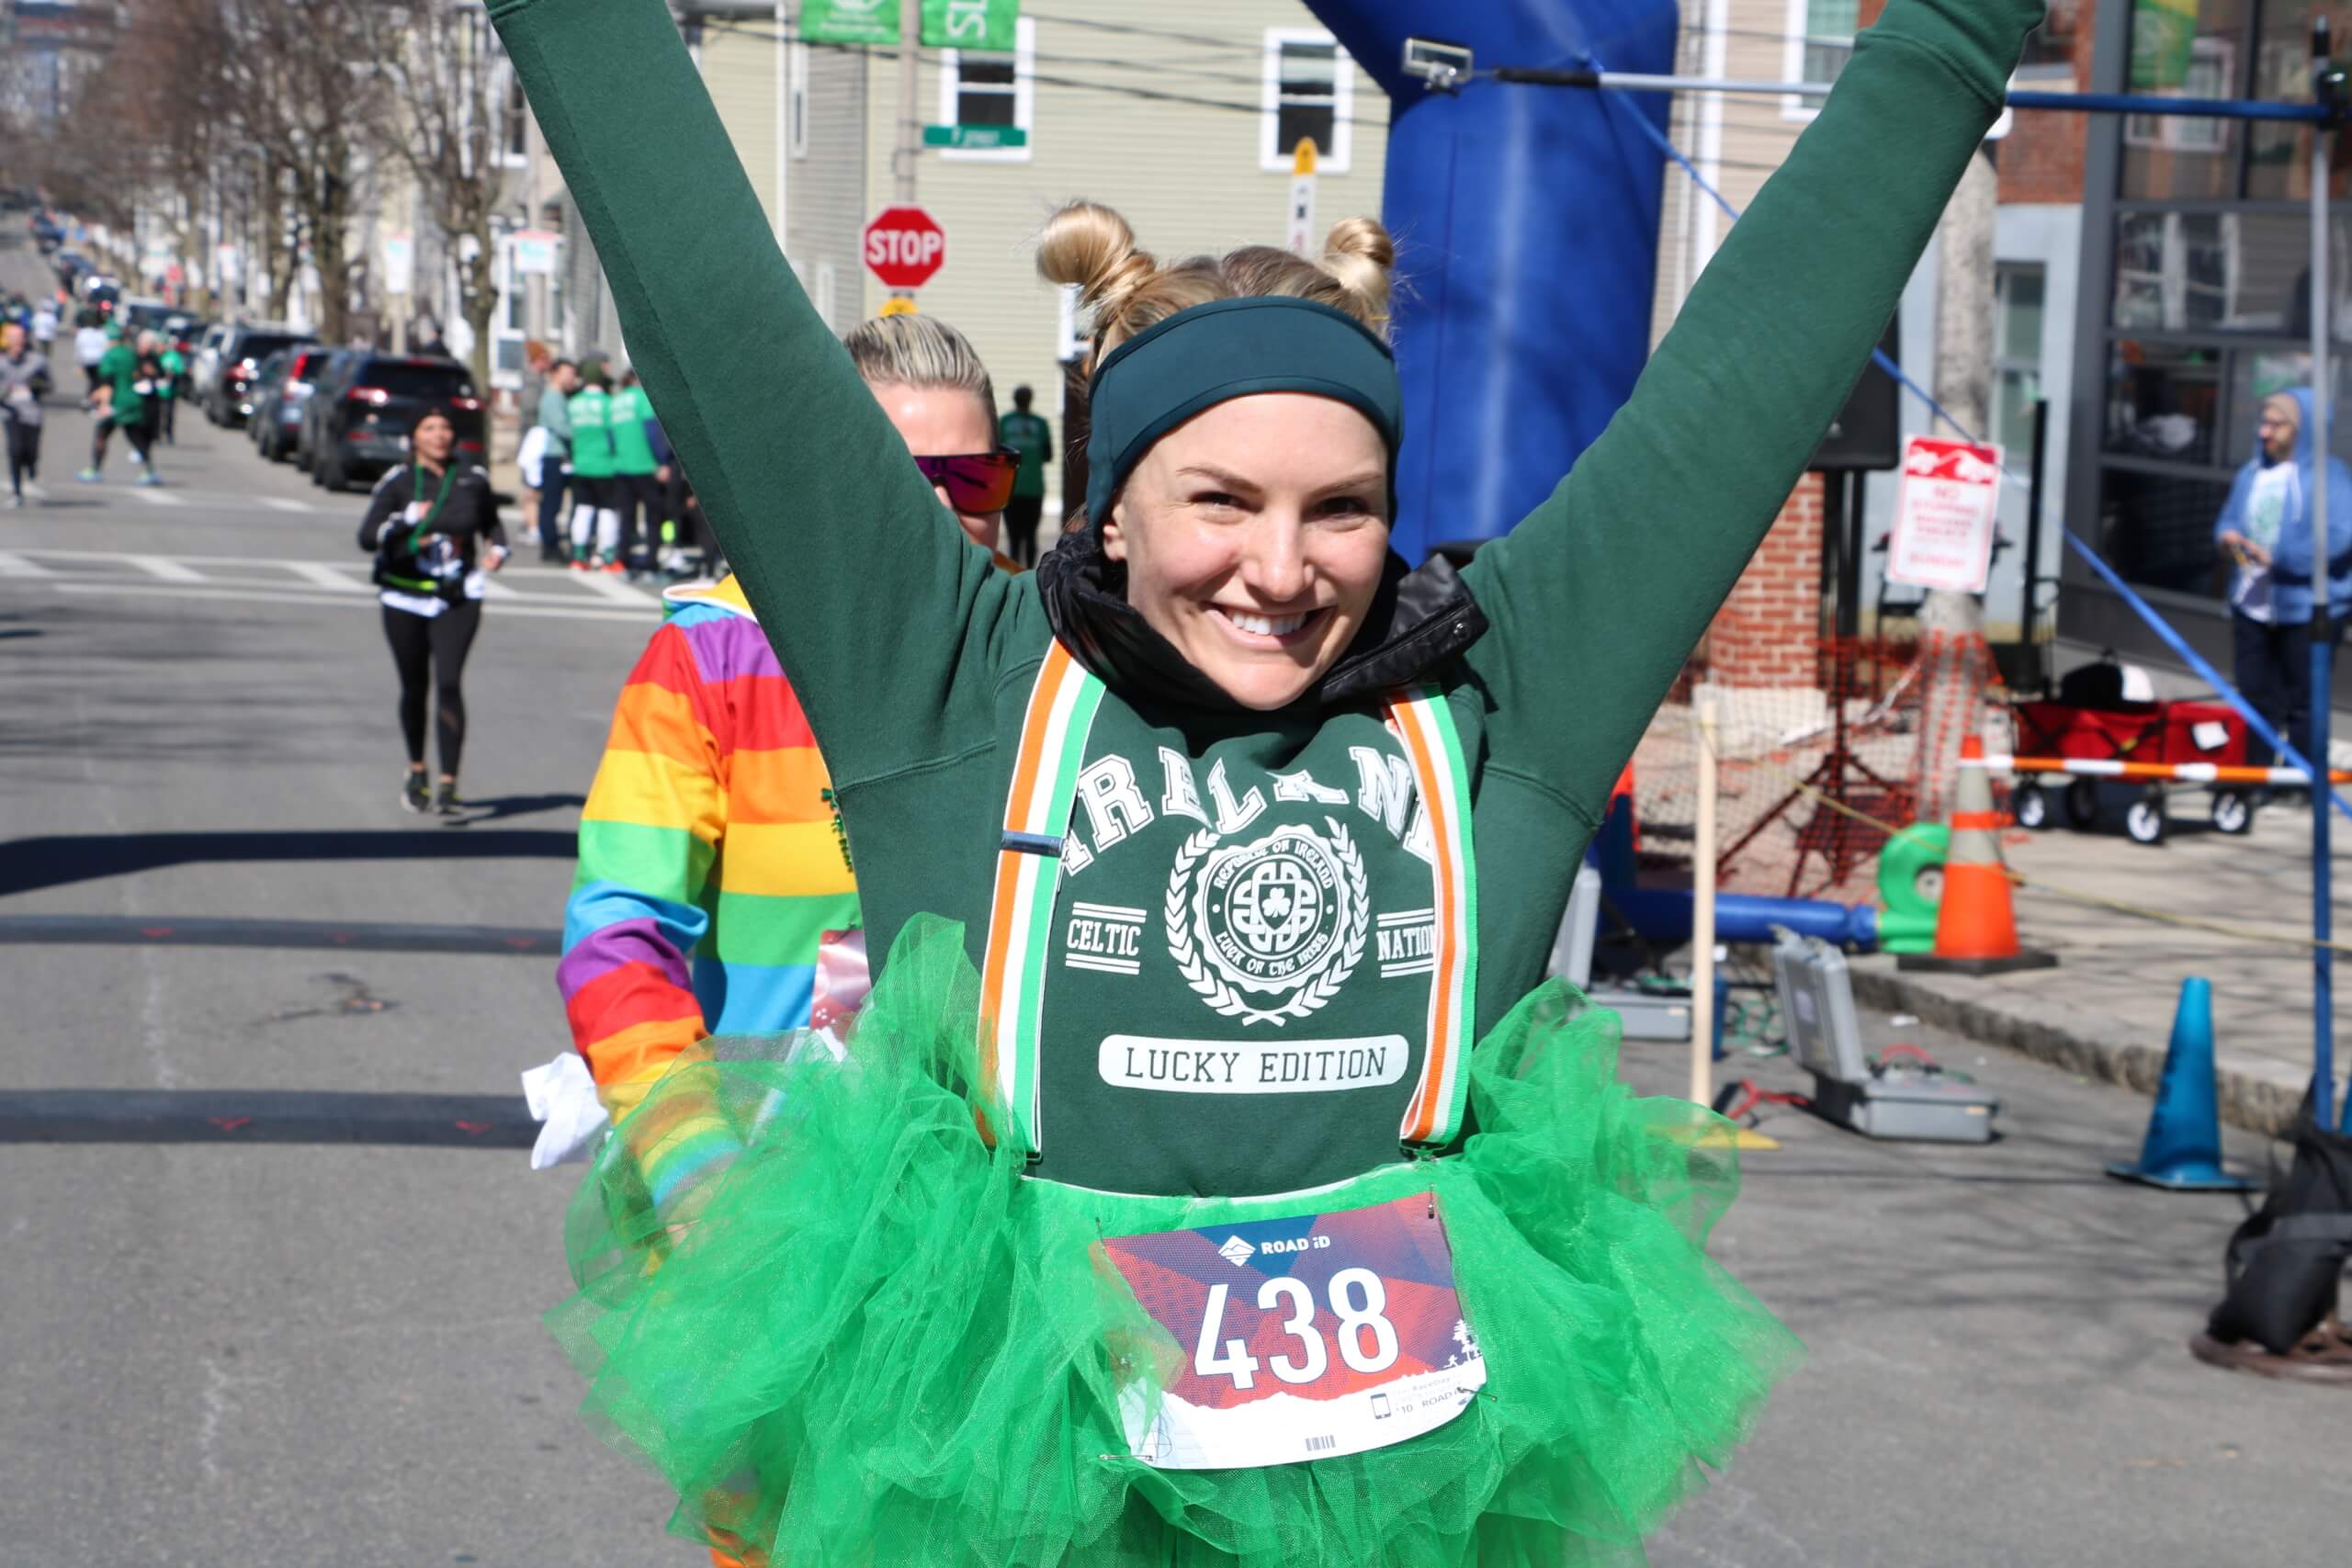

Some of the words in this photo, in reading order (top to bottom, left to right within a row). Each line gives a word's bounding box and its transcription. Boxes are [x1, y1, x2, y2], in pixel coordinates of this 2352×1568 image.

[867, 229, 942, 265] STOP
[1294, 840, 1334, 889] IRELAND
[1067, 919, 1142, 956] CELTIC
[1216, 931, 1246, 965] LUCK
[1296, 932, 1329, 965] IRISH
[1125, 1047, 1240, 1083] LUCKY
[1259, 1046, 1387, 1083] EDITION
[1261, 1237, 1309, 1255] ROAD
[1194, 1268, 1399, 1390] 438
[1421, 1391, 1453, 1408] ROAD
